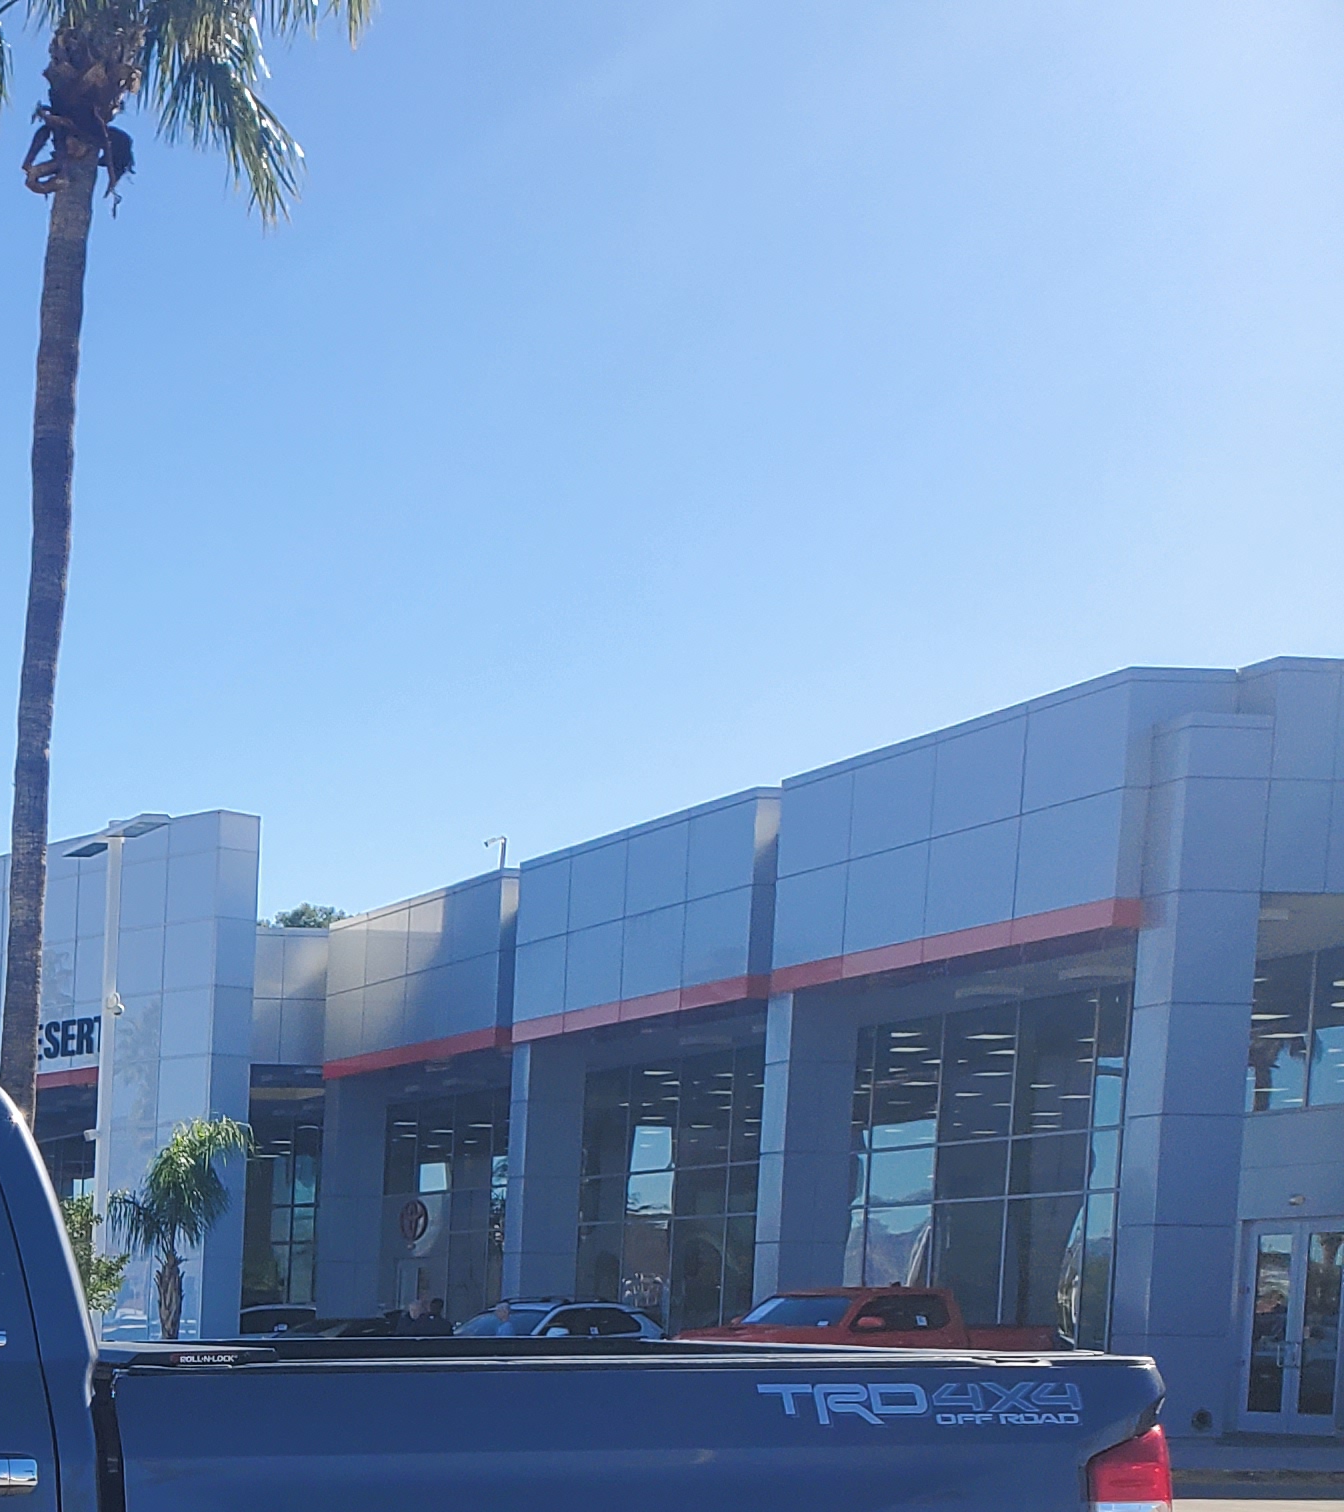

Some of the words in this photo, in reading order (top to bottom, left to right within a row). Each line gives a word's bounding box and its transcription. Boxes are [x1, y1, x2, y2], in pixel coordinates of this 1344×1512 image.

[757, 1383, 928, 1425] TRD
[936, 1413, 993, 1425] OFF
[999, 1413, 1080, 1425] ROAD
